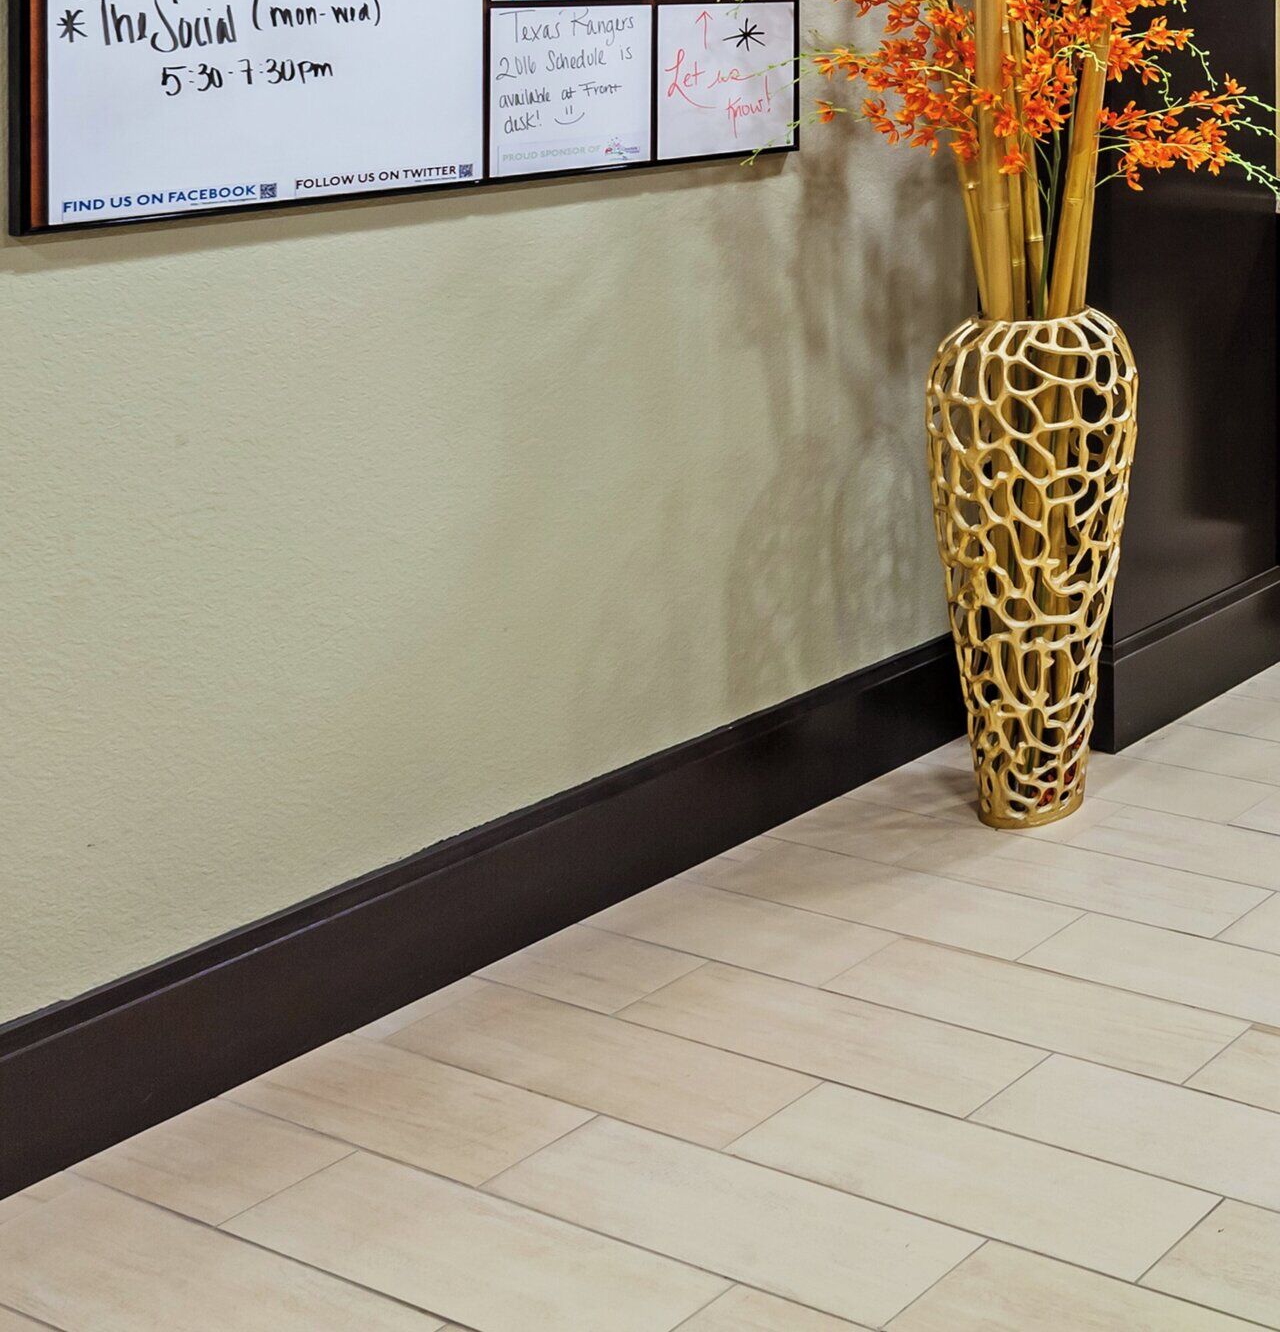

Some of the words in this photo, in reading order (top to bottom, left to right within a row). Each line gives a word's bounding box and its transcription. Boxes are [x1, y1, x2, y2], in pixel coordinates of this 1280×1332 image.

[571, 7, 635, 47] Rangers
[496, 56, 537, 82] 2016
[620, 44, 633, 61] is
[665, 48, 717, 109] Let
[499, 86, 551, 109] available
[561, 86, 577, 101] at
[502, 149, 538, 162] PROUD
[540, 145, 587, 160] SPONSOR
[295, 175, 355, 191] FOLLOW
[357, 172, 376, 184] US
[378, 170, 400, 182] ON
[402, 165, 457, 180] TWITTER
[63, 199, 105, 214] FIND
[110, 196, 132, 209] US
[136, 193, 164, 206] ON
[167, 184, 257, 203] FACEBOOK
